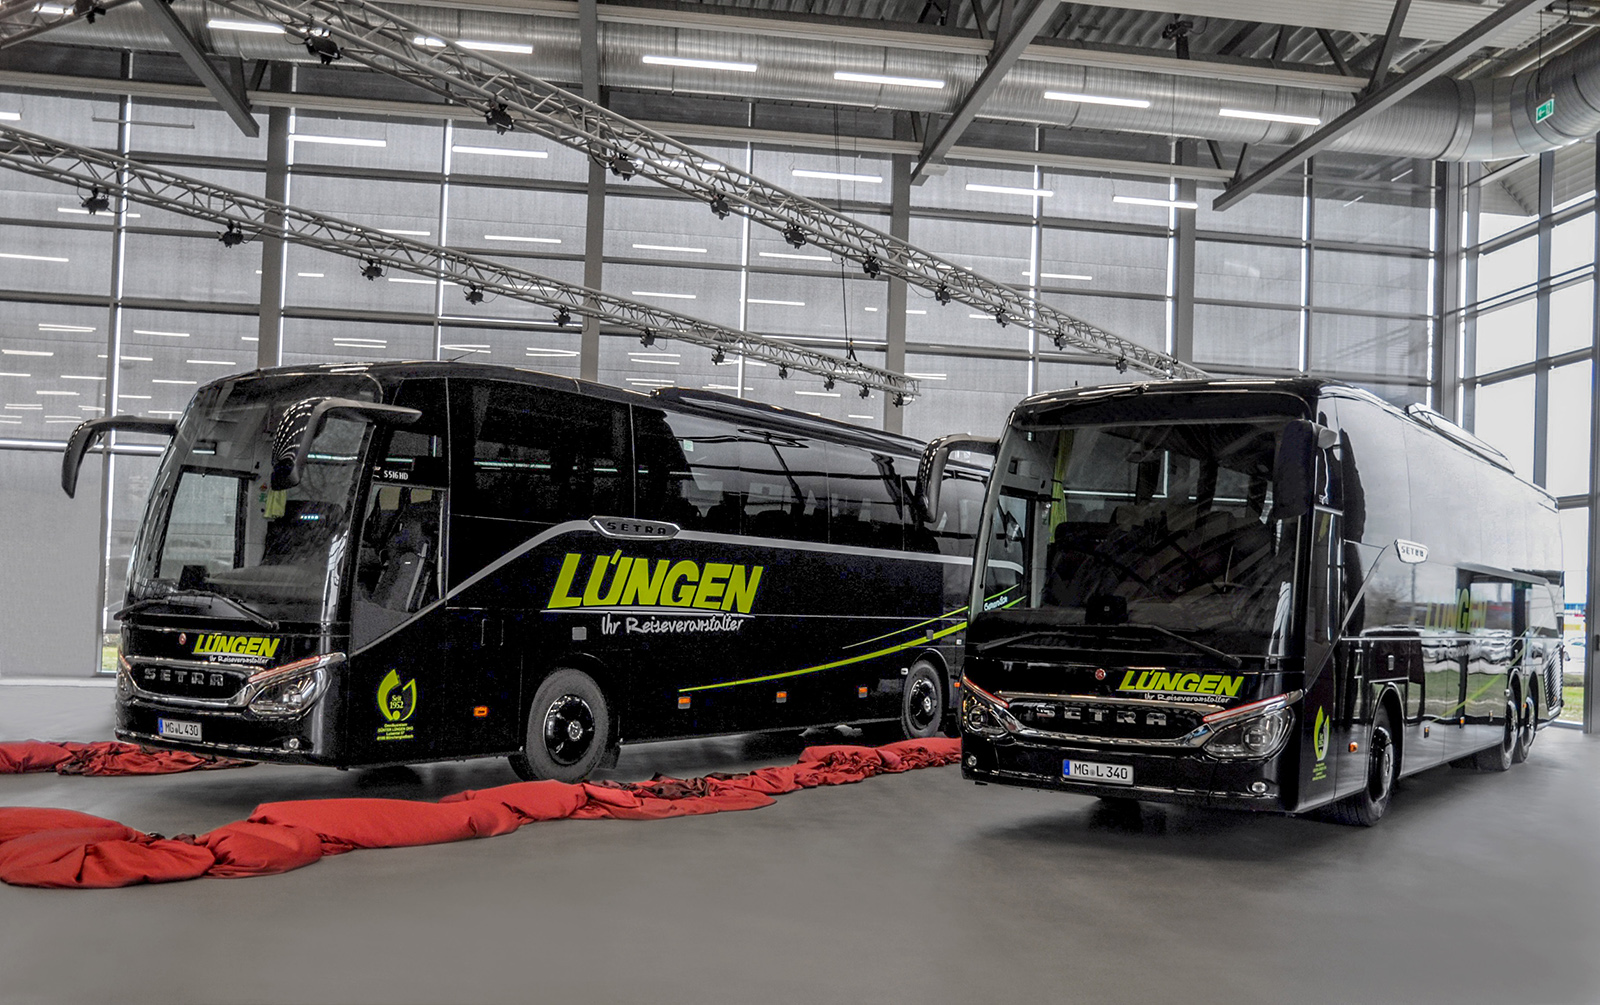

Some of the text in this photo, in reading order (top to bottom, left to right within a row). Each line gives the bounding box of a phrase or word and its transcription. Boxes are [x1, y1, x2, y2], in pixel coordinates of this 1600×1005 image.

[606, 521, 667, 535] SETRA
[601, 612, 744, 635] Ihr Reiseveranstalter
[144, 667, 224, 687] SETRA
[1036, 705, 1167, 726] SETRA
[165, 721, 175, 733] MG
[184, 724, 199, 736] 430
[1073, 763, 1090, 776] MG
[1105, 766, 1129, 780] 340
